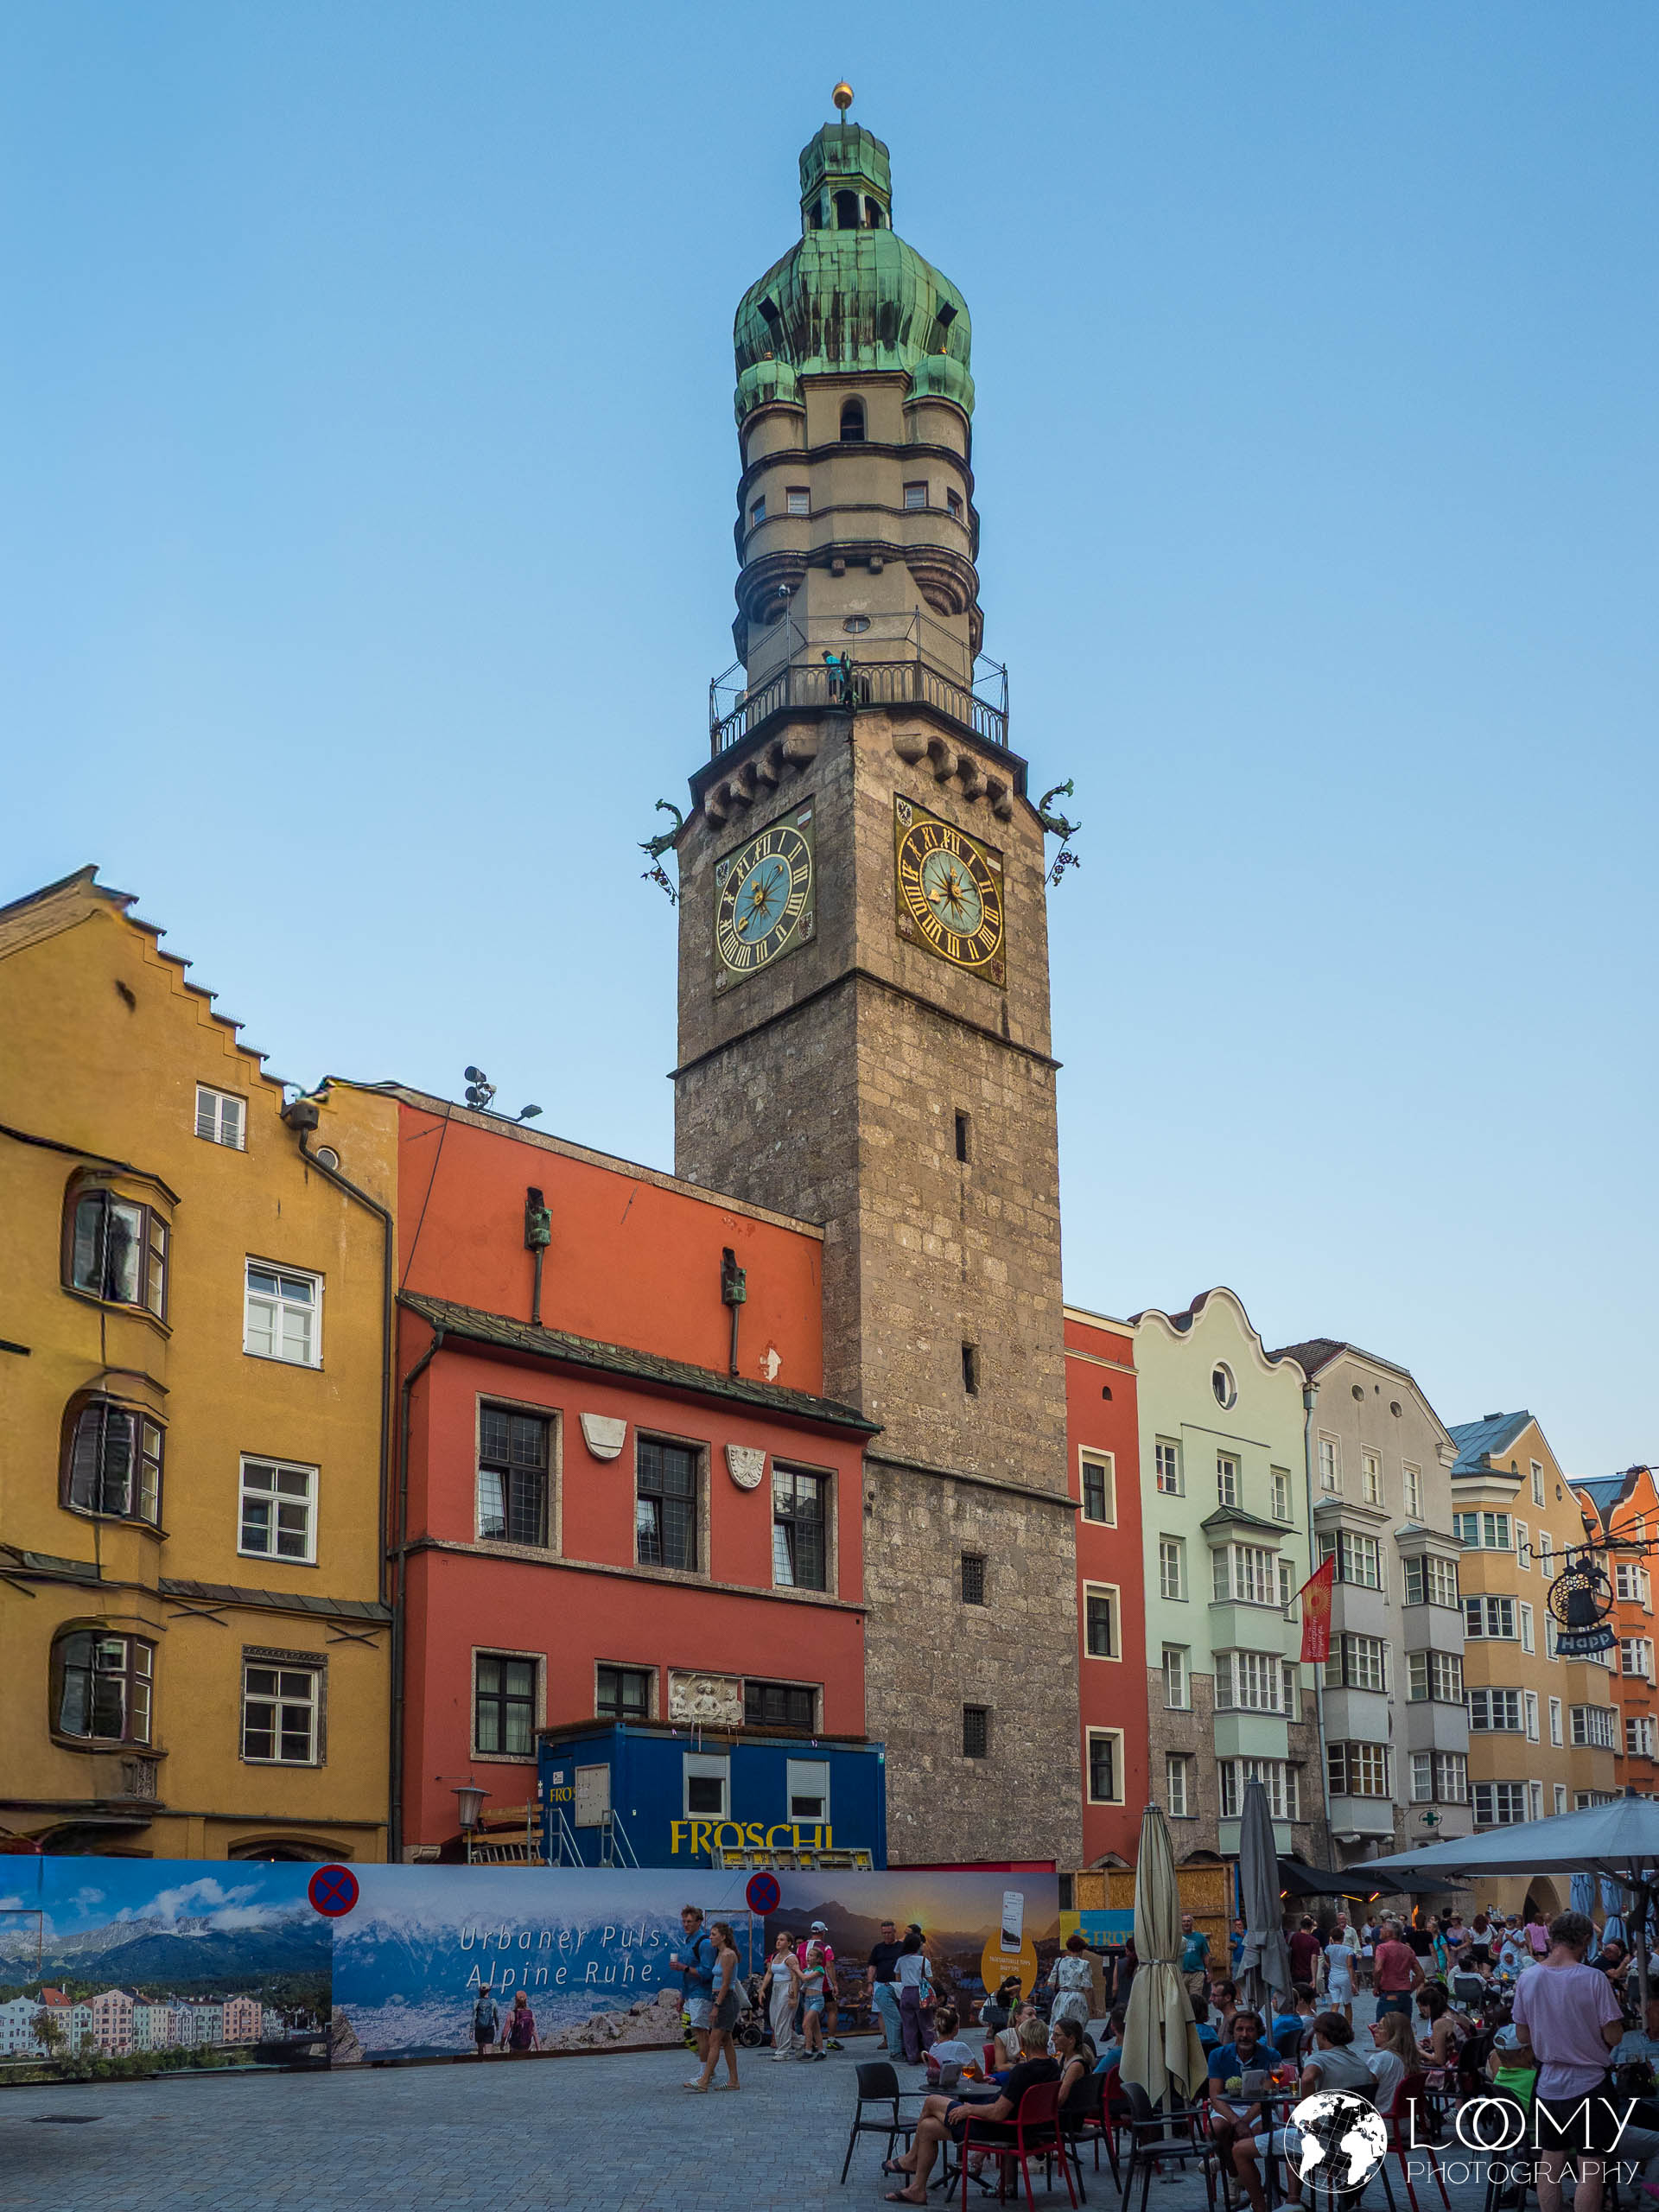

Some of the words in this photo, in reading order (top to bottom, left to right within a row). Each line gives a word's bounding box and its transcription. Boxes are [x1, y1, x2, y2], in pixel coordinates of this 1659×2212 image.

[1562, 1633, 1610, 1649] Happ
[461, 1924, 587, 1950] Urbaner
[602, 1923, 669, 1948] Puls.
[467, 1961, 567, 1994] Alpine
[585, 1958, 661, 1984] Ruhe.
